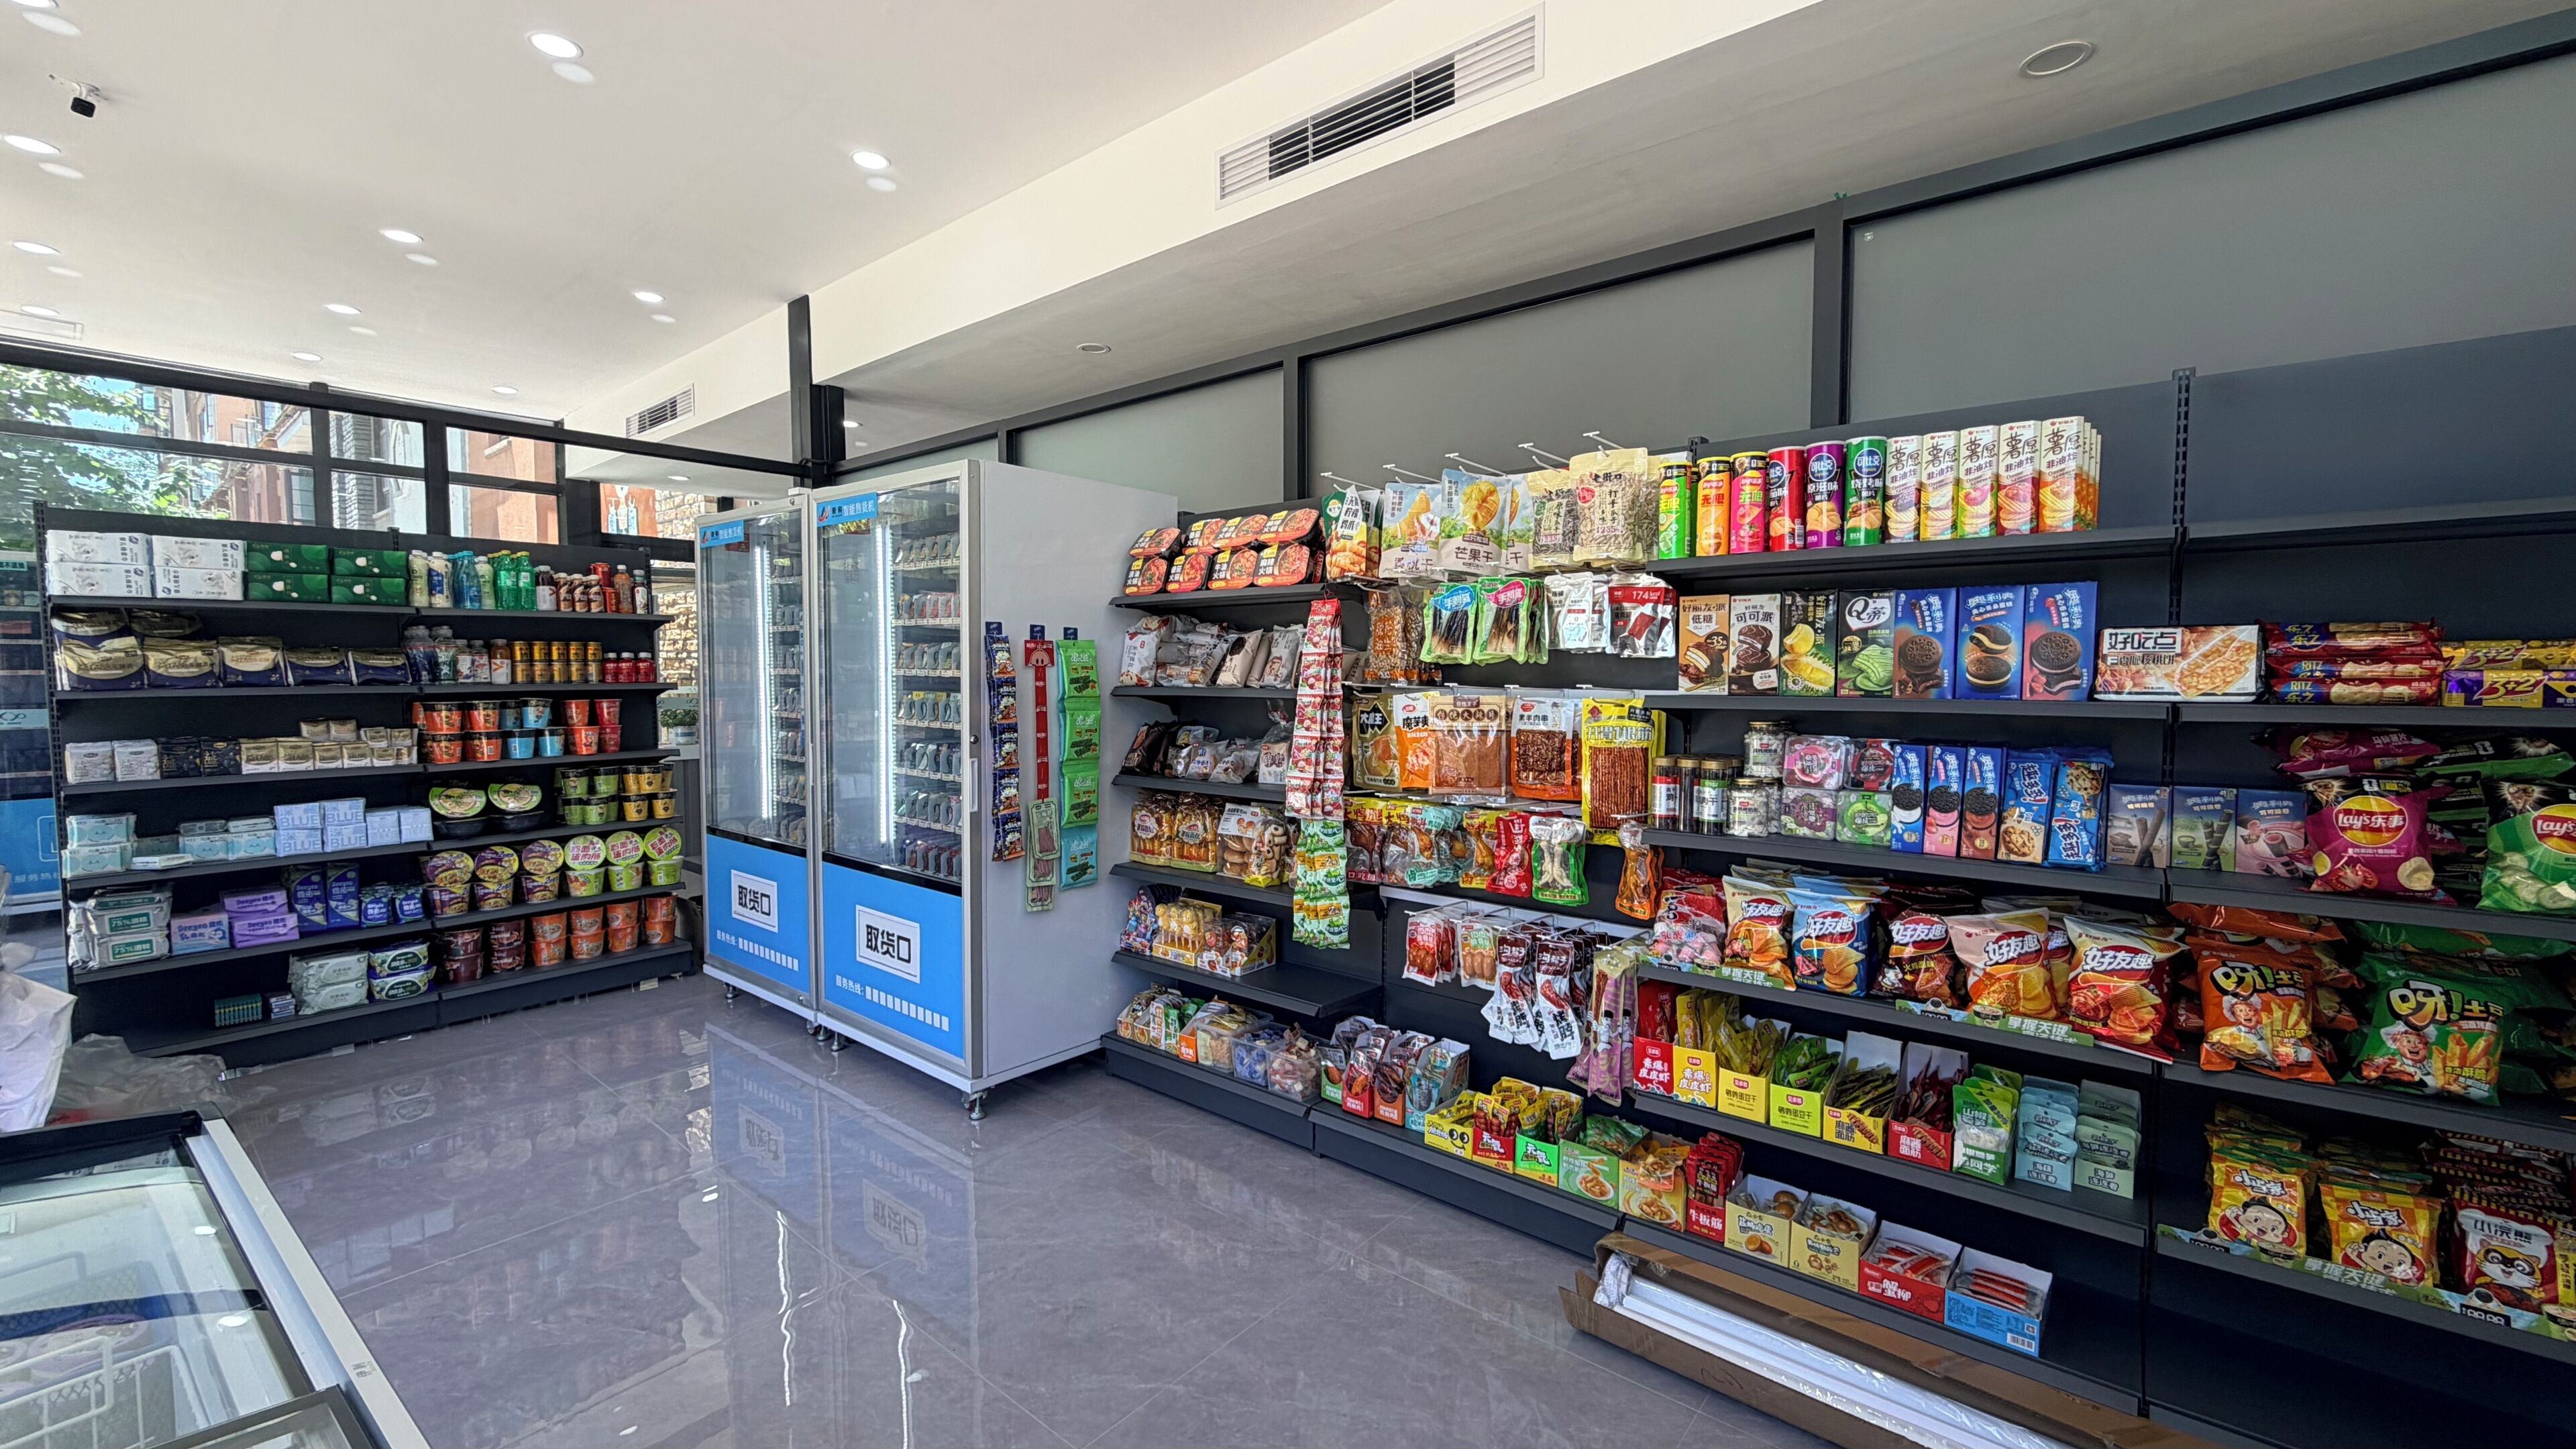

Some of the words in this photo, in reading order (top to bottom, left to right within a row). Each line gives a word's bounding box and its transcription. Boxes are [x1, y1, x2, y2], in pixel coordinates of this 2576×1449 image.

[2000, 431, 2039, 464] 薯愿
[2043, 427, 2082, 459] 薯愿
[1924, 441, 1957, 470] 薯愿
[1962, 437, 1997, 466] 薯愿
[1811, 458, 1834, 471] 可比克
[1857, 454, 1880, 467] 可比克
[1888, 446, 1922, 474] 薯愿
[2004, 455, 2035, 472] 非油炸
[2046, 451, 2078, 468] 非油炸
[1927, 465, 1955, 480] 非油炸
[1964, 460, 1994, 476] 非油炸
[1851, 478, 1883, 489] 烧烤味
[1890, 469, 1918, 483] 非油炸
[1807, 480, 1839, 493] 原滋味
[843, 500, 875, 517] 智能售货机
[1344, 507, 1358, 519] 柠檬
[1260, 557, 1275, 567] 麻辣
[1454, 546, 1494, 563] 芒果干
[1214, 562, 1228, 572] 牛油
[1258, 566, 1275, 576] 火锅
[1126, 576, 1138, 586] 火锅
[1168, 573, 1181, 582] 火锅
[1212, 570, 1228, 580] 火锅
[1632, 591, 1650, 600] 174
[1966, 592, 2014, 607] 奥利奥
[1691, 614, 1714, 625] 低糖
[1734, 611, 1774, 623] 可可派
[2107, 631, 2178, 651] 好吃点
[2302, 660, 2324, 671] RITZ
[2290, 681, 2313, 691] RITZ
[2480, 675, 2537, 700] 3+2
[1359, 712, 1383, 724] 大魔王
[280, 814, 318, 829] BLUE
[325, 810, 365, 824] BLUE
[283, 839, 321, 853] BLUE
[329, 835, 366, 848] BLUE
[737, 885, 771, 917] 取货口
[1741, 902, 1786, 920] 好友趣
[1804, 914, 1856, 938] 好友趣
[1890, 921, 1948, 944] 好友趣
[865, 924, 912, 964] 取货口
[1983, 933, 2041, 966] 好友趣
[2082, 946, 2156, 971] 好友趣
[1638, 1068, 1670, 1083] 皮皮虾
[1678, 1078, 1713, 1094] 皮皮虾
[2233, 1169, 2288, 1198] 小当家
[1689, 1208, 1723, 1230] 牛板筋
[2347, 1199, 2408, 1228] 小当家
[2474, 1218, 2533, 1244] 小浣熊
[1882, 1278, 1912, 1301] 蟹柳
